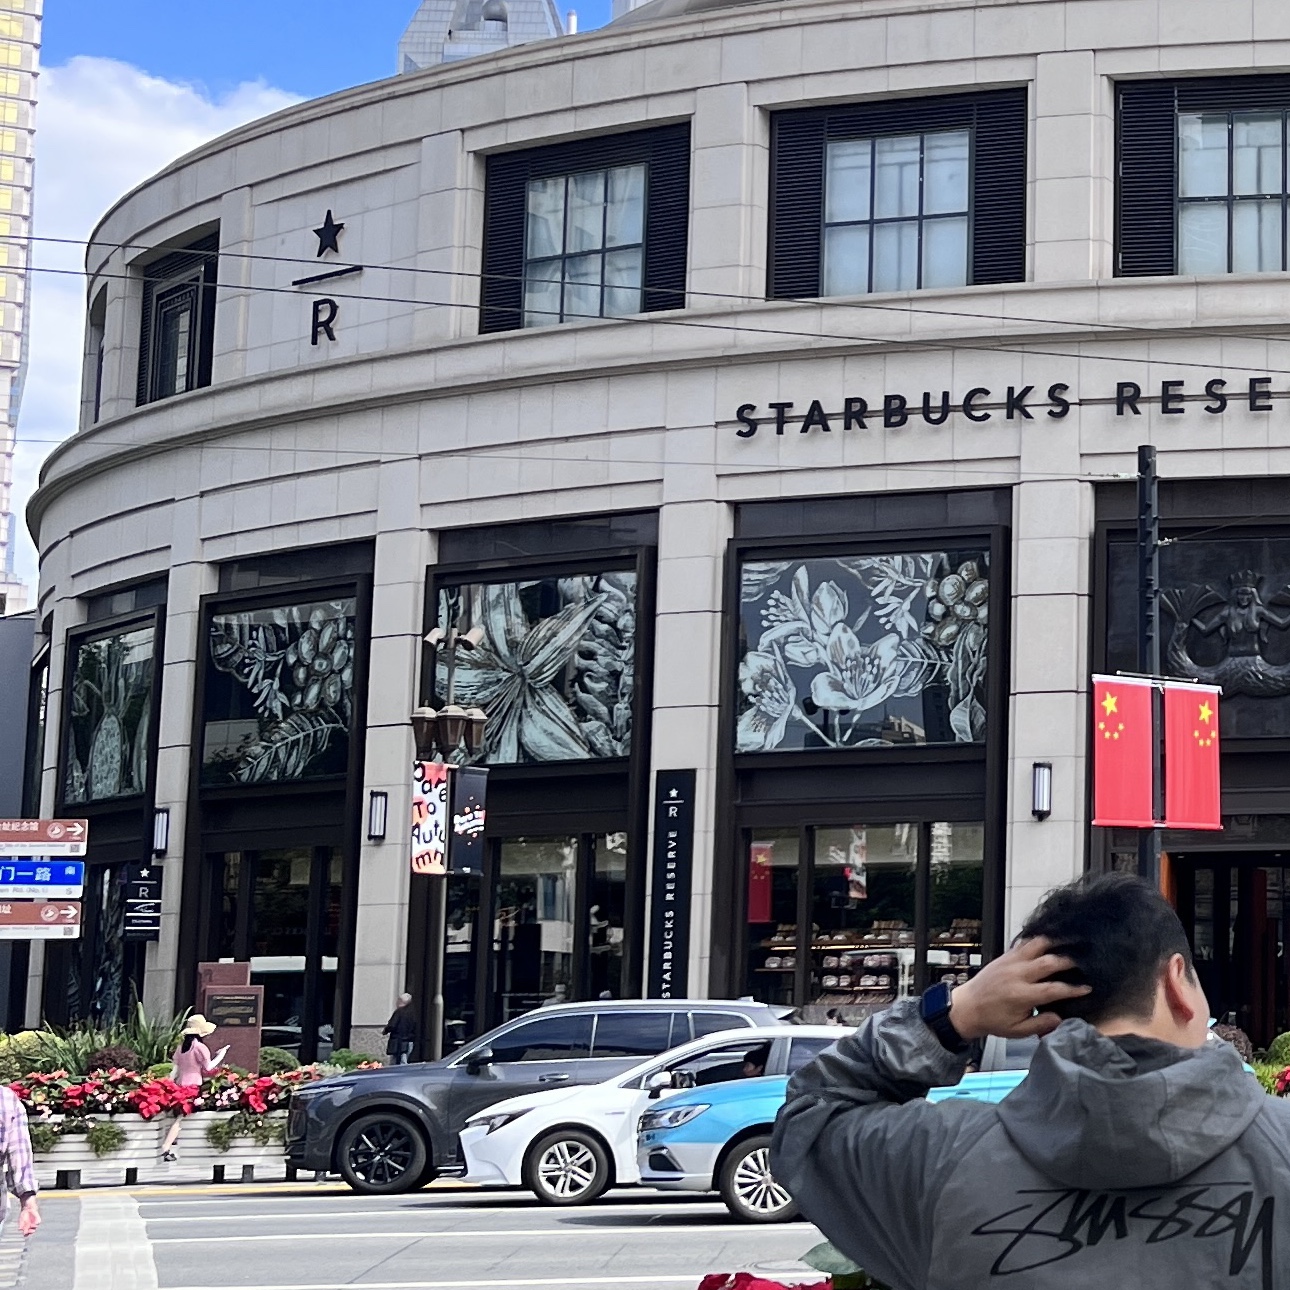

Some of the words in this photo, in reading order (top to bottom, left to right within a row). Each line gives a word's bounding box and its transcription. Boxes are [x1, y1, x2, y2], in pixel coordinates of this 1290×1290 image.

[311, 298, 339, 345] R
[736, 383, 1070, 438] STARBUCKS
[668, 805, 678, 818] R
[665, 830, 678, 901] RESERVE
[139, 886, 149, 898] R
[661, 910, 675, 998] STARBUCKS
